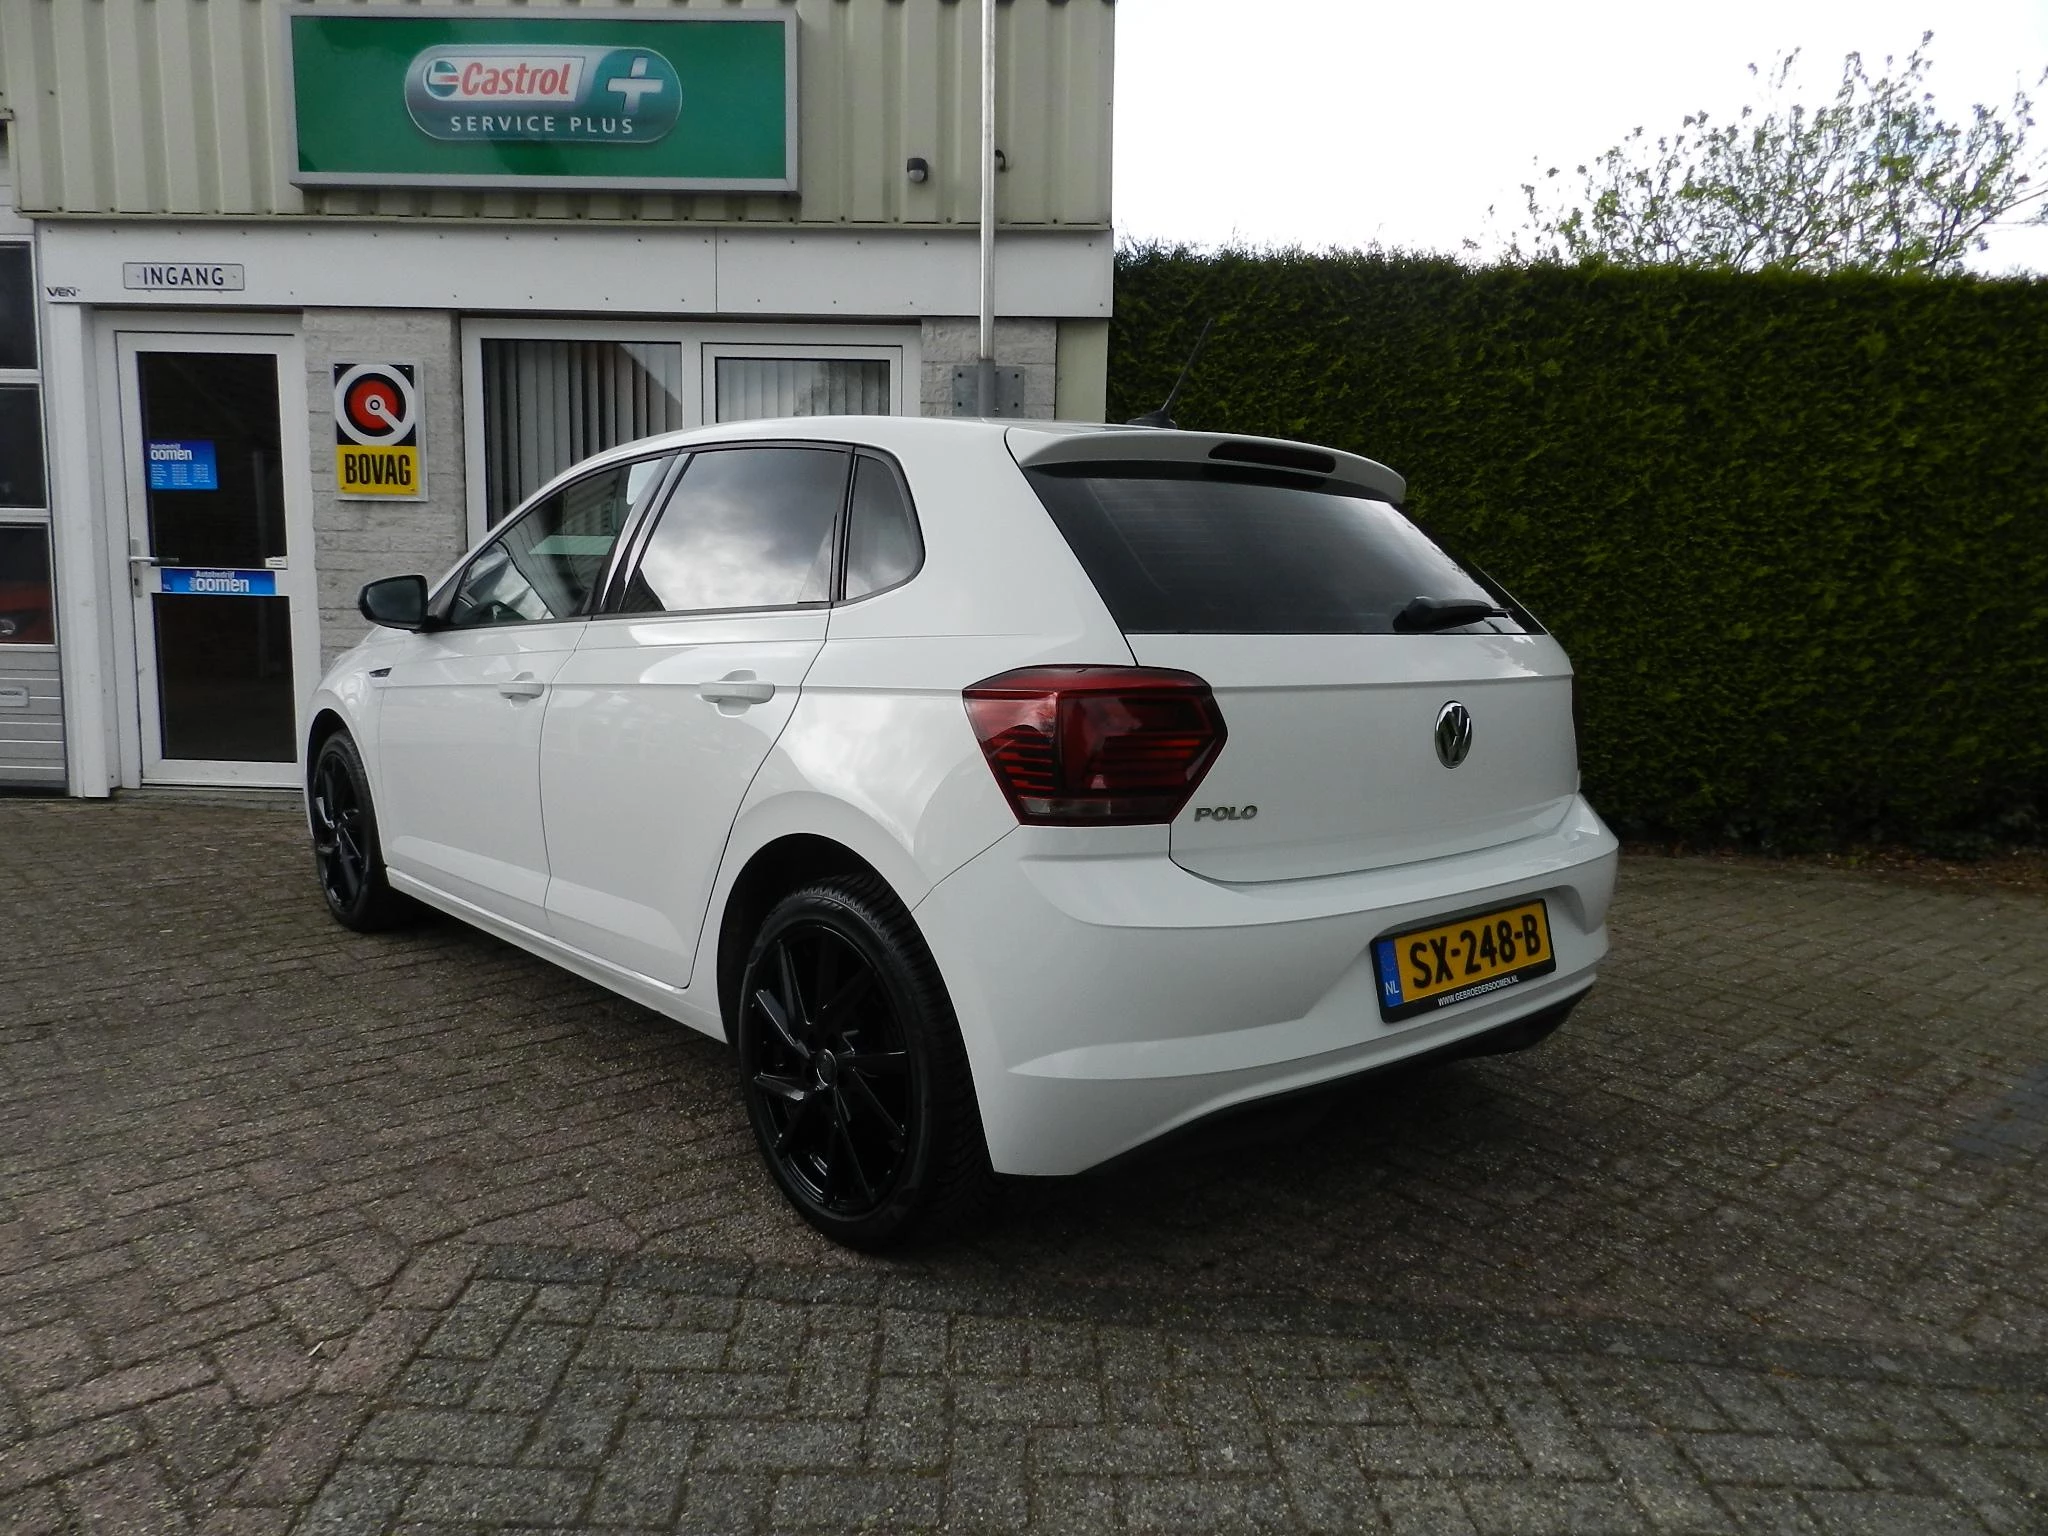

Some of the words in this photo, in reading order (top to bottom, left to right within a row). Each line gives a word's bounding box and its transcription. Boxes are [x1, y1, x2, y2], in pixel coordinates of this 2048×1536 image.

[461, 62, 571, 96] Castrol
[451, 116, 555, 133] SERVICE
[570, 116, 633, 134] PLUS
[143, 267, 224, 286] INGANG
[344, 453, 412, 486] BOVAG
[1194, 804, 1258, 822] POLO
[1409, 913, 1541, 989] SX-248-B
[1385, 981, 1400, 996] NL
[1437, 975, 1519, 1007] WWW.GEBROEDERSOOMEN.NL
